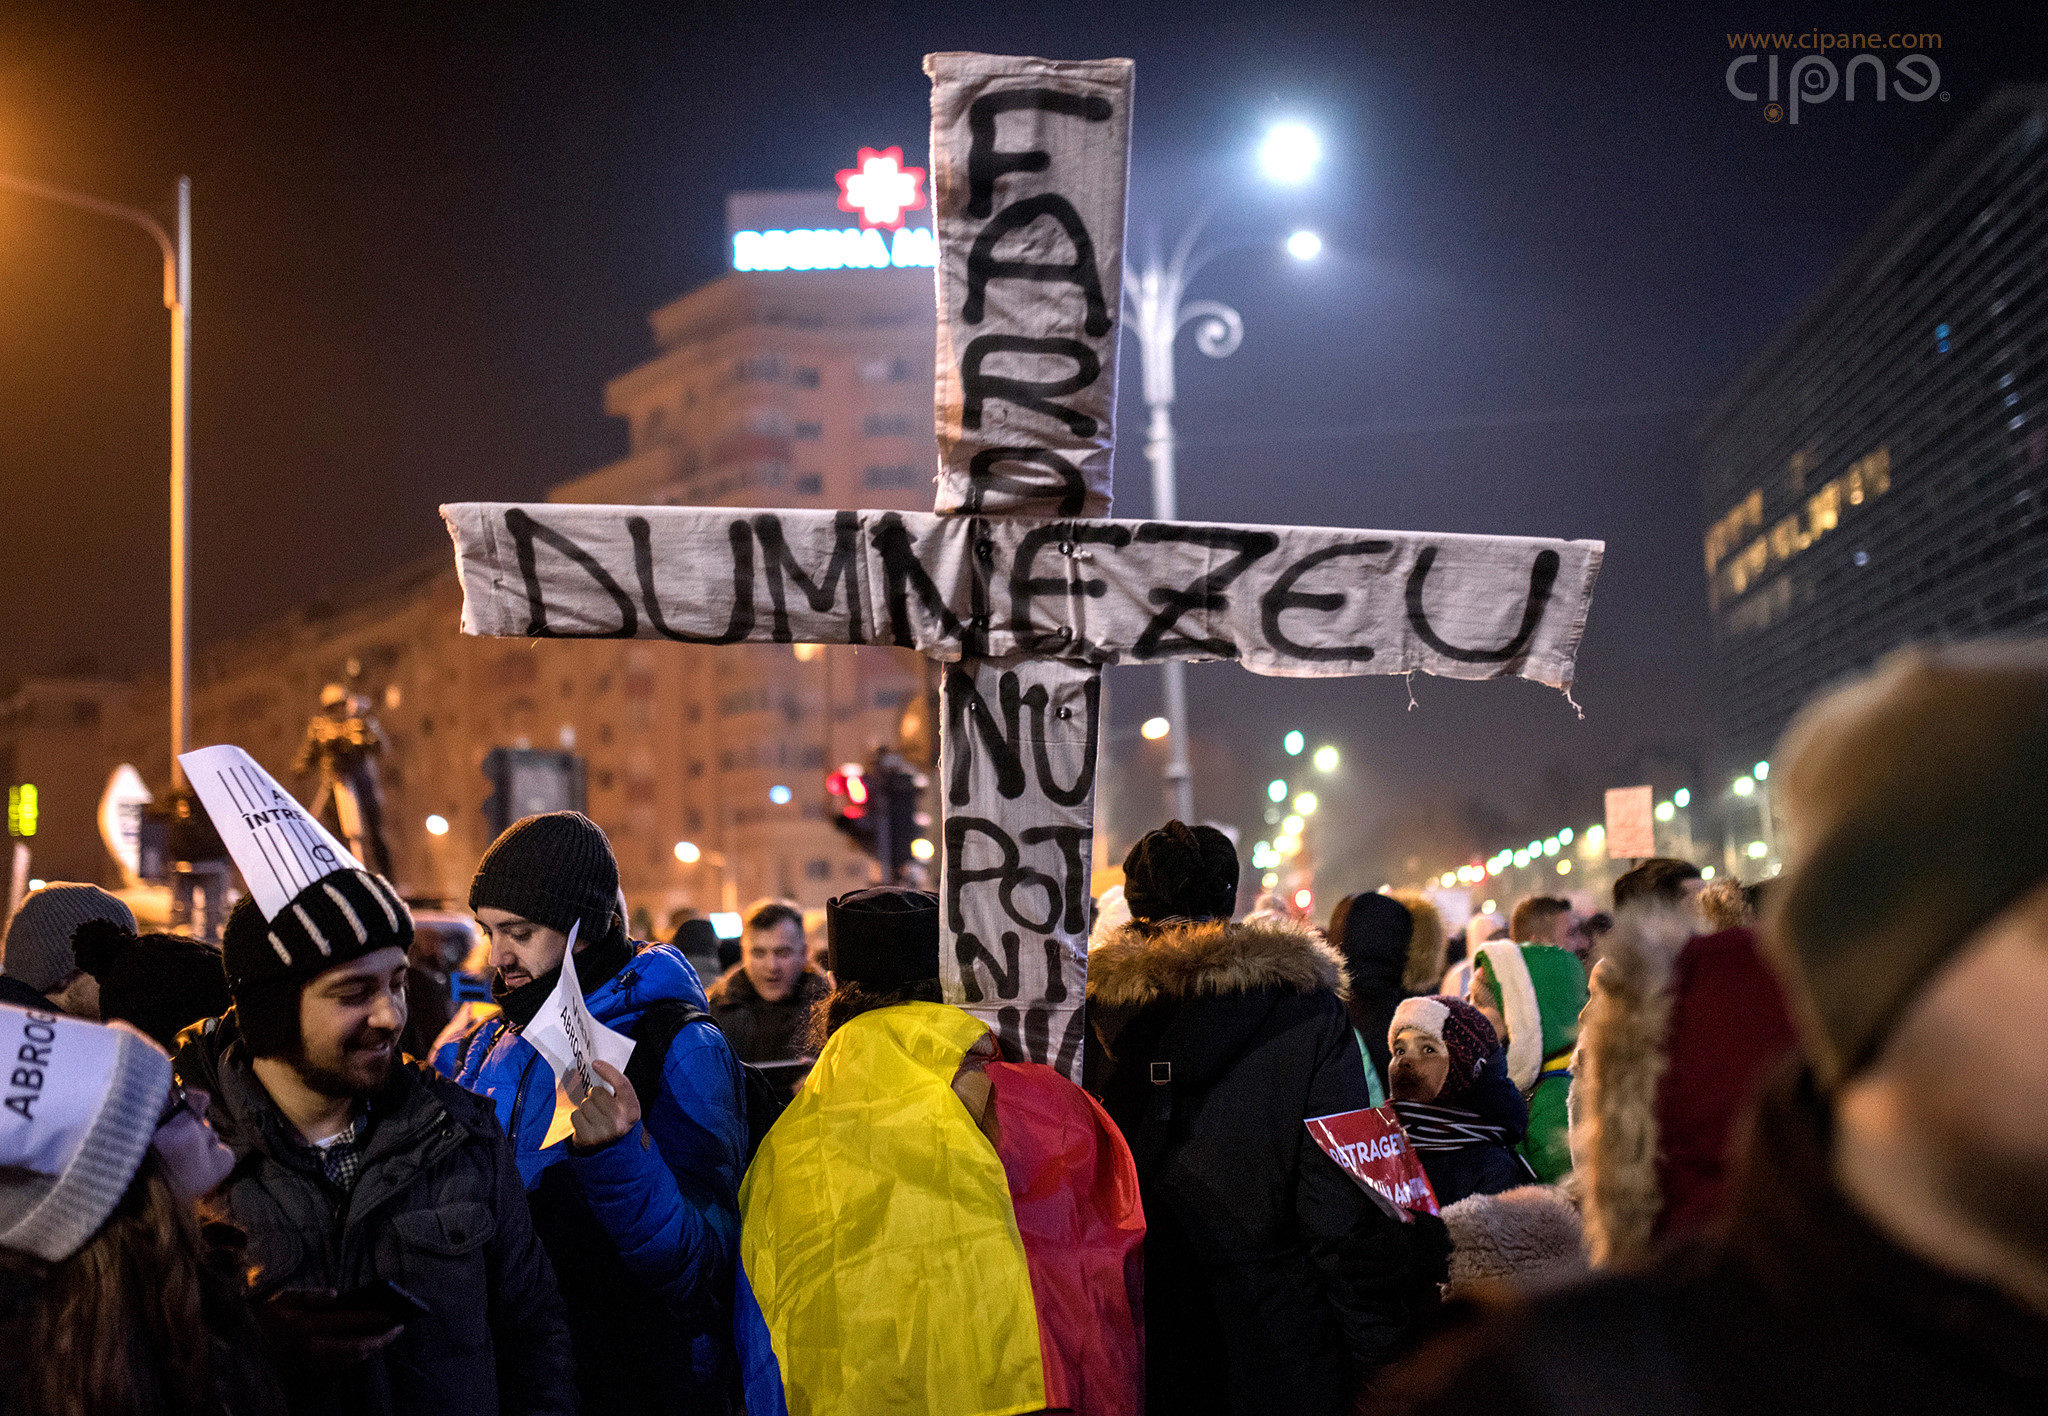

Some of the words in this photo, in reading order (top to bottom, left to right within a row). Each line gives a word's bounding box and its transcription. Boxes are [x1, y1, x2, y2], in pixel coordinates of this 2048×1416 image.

[504, 508, 1560, 663] DUMNEZEU
[947, 670, 1100, 807] NU
[945, 816, 1093, 935] POT
[955, 931, 1068, 1003] NI
